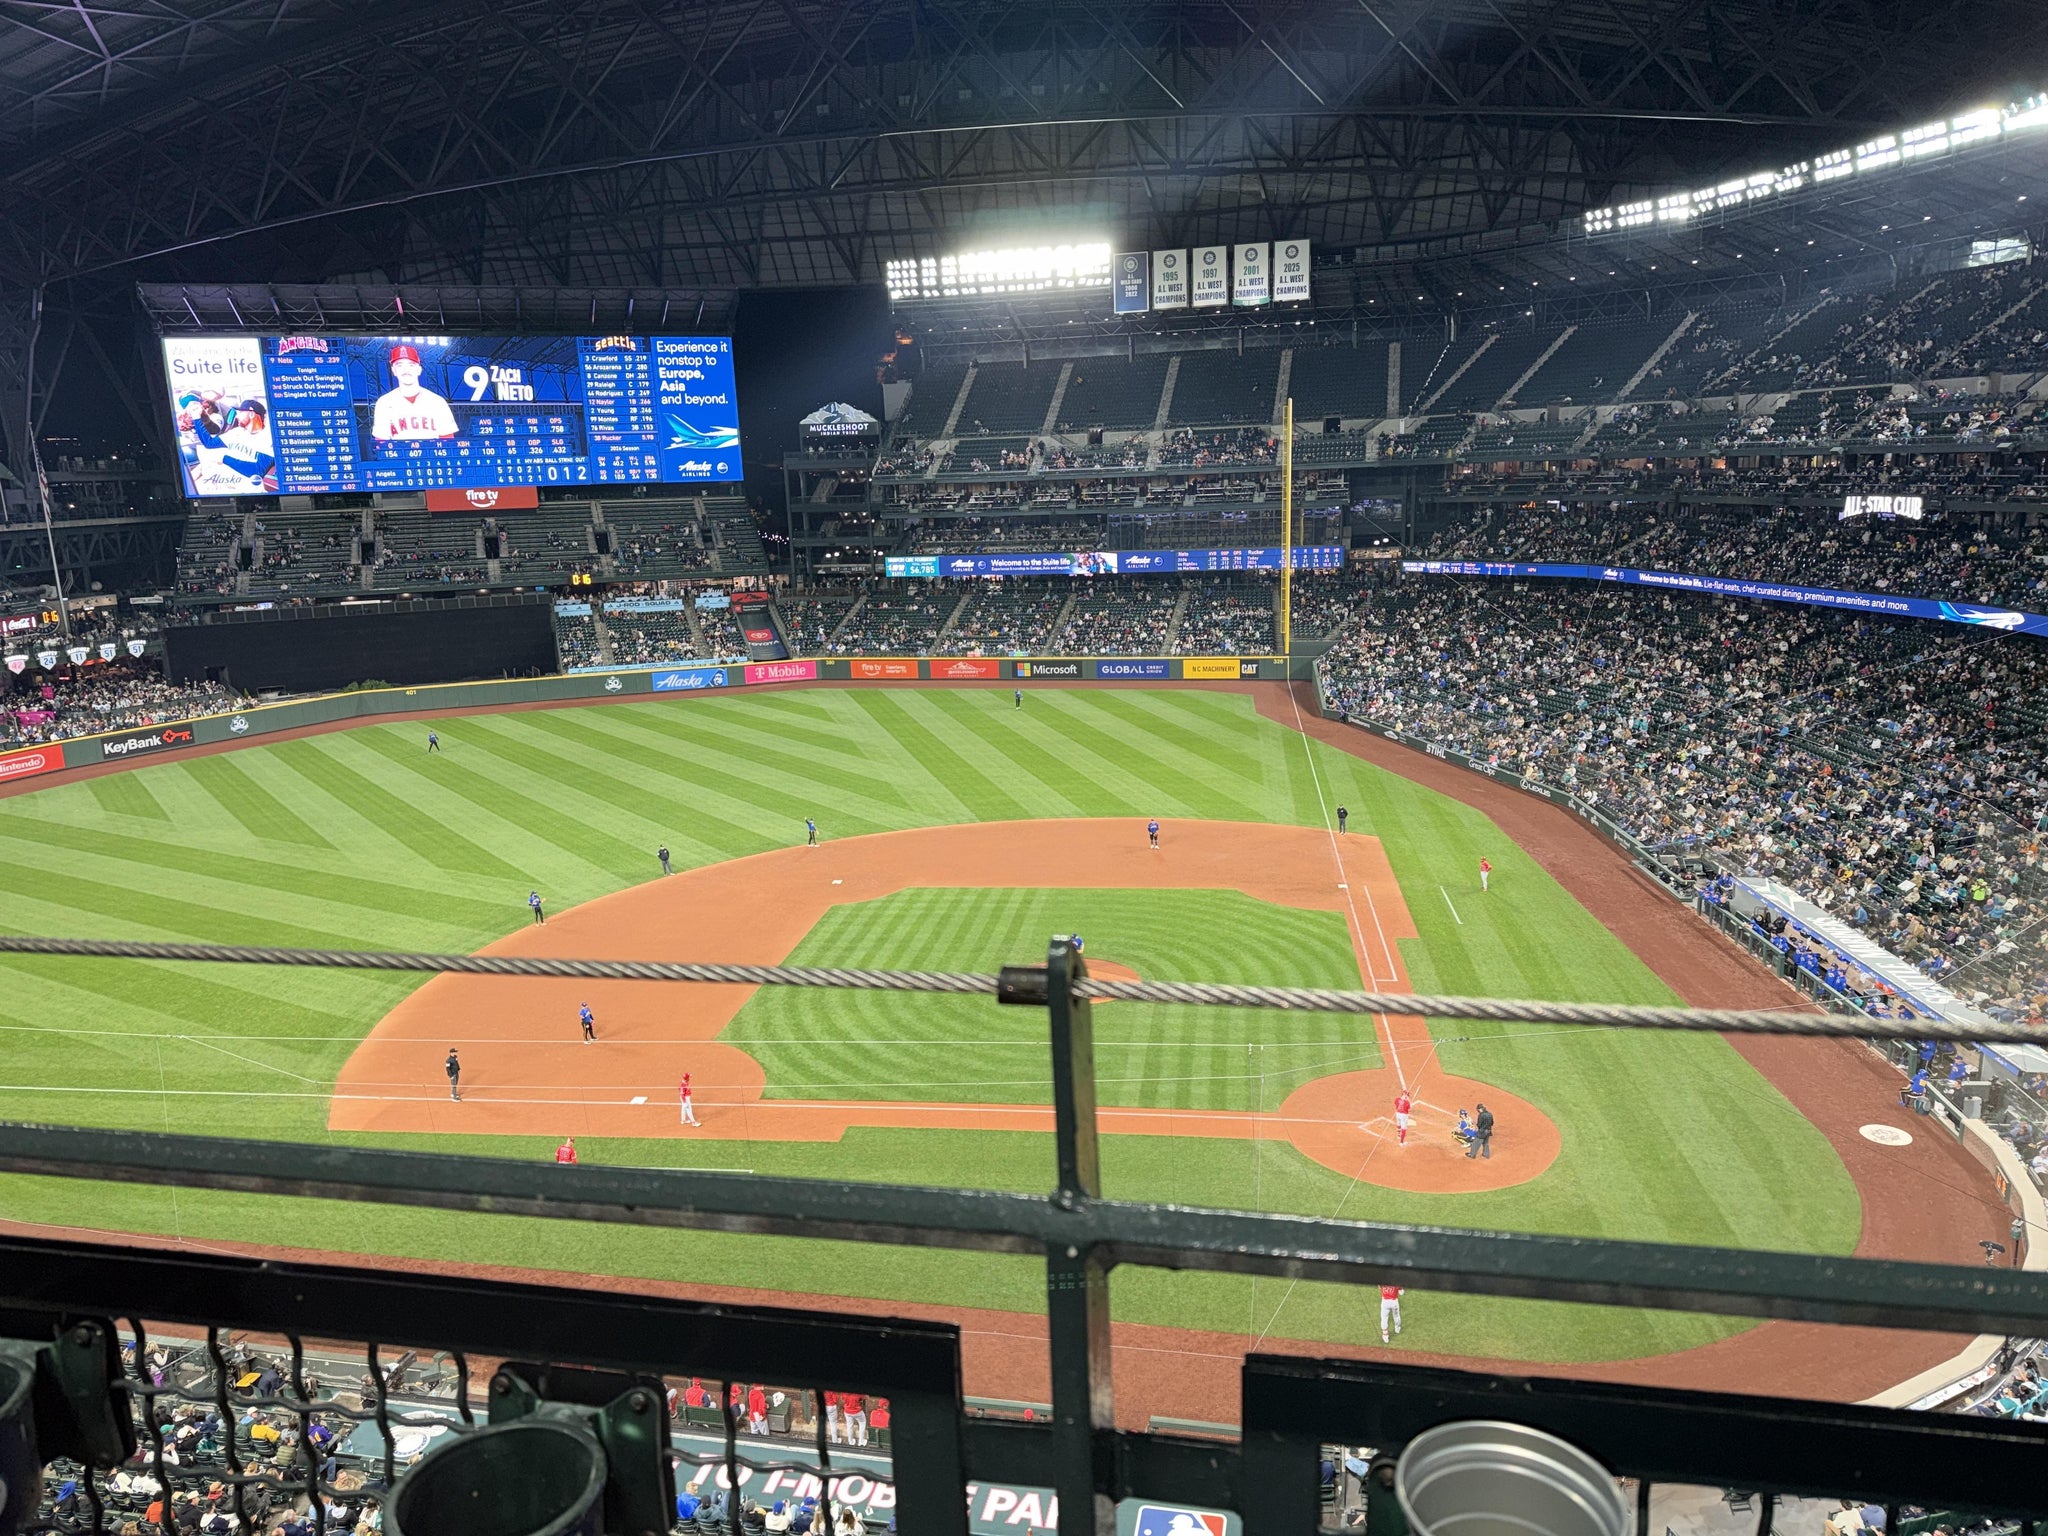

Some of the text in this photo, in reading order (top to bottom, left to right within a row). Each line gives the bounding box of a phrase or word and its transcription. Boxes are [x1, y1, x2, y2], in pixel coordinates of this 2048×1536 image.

[1244, 265, 1259, 275] 2001
[1284, 263, 1300, 272] 2025
[1163, 272, 1178, 281] 1995
[1202, 269, 1217, 278] 1997
[1249, 278, 1264, 286] WEST
[1290, 275, 1304, 283] WEST
[1169, 284, 1182, 292] WEST
[1208, 281, 1222, 289] WEST
[1236, 288, 1267, 298] CHAMPIONS
[1276, 286, 1307, 295] CHAMPIONS
[1156, 294, 1186, 304] CHAMPIONS
[1195, 292, 1225, 301] CHAMPIONS
[279, 337, 328, 355] ANGELS
[657, 341, 728, 354] Experience it
[173, 358, 257, 374] Suite life
[658, 355, 717, 367] nonstop to
[490, 366, 521, 382] ZACH
[659, 368, 704, 380] Europe,
[463, 366, 489, 401] 9
[660, 380, 685, 391] Asia
[498, 382, 533, 401] NETO
[661, 393, 728, 406] and beyond.
[810, 423, 869, 432] MUCKLESHOOT
[678, 461, 712, 471] Alaska
[548, 467, 557, 480] 0
[564, 467, 569, 480] 1
[577, 466, 586, 480] 2
[203, 474, 242, 484] Alaska
[466, 490, 498, 500] fire tv
[1893, 497, 1922, 520] CLUB
[1031, 558, 1041, 566] the
[1125, 556, 1151, 564] Alaska
[910, 566, 935, 574] $6,785
[572, 574, 591, 585] 0:16
[1639, 573, 1662, 583] Welcome
[1679, 578, 1692, 586] Suite
[1704, 580, 1723, 589] Lie-flat
[1724, 583, 1741, 592] seats,
[1742, 585, 1781, 596] chef-curated
[1782, 590, 1803, 600] dining,
[1805, 593, 1834, 603] premium
[1835, 595, 1870, 606] amenities
[1872, 599, 1886, 608] and
[1887, 601, 1910, 611] more.
[42, 610, 58, 623] 0:16
[768, 666, 806, 678] Mobile
[1033, 664, 1078, 675] Microsoft
[1102, 665, 1145, 674] GLOBAL
[1202, 665, 1235, 673] MACHINERY
[1241, 664, 1258, 674] CAT
[656, 674, 702, 688] Alaska
[104, 735, 162, 755] KeyBank
[1426, 744, 1446, 759] STIHL
[1469, 760, 1483, 771] Great
[1528, 784, 1551, 797] LEXUS
